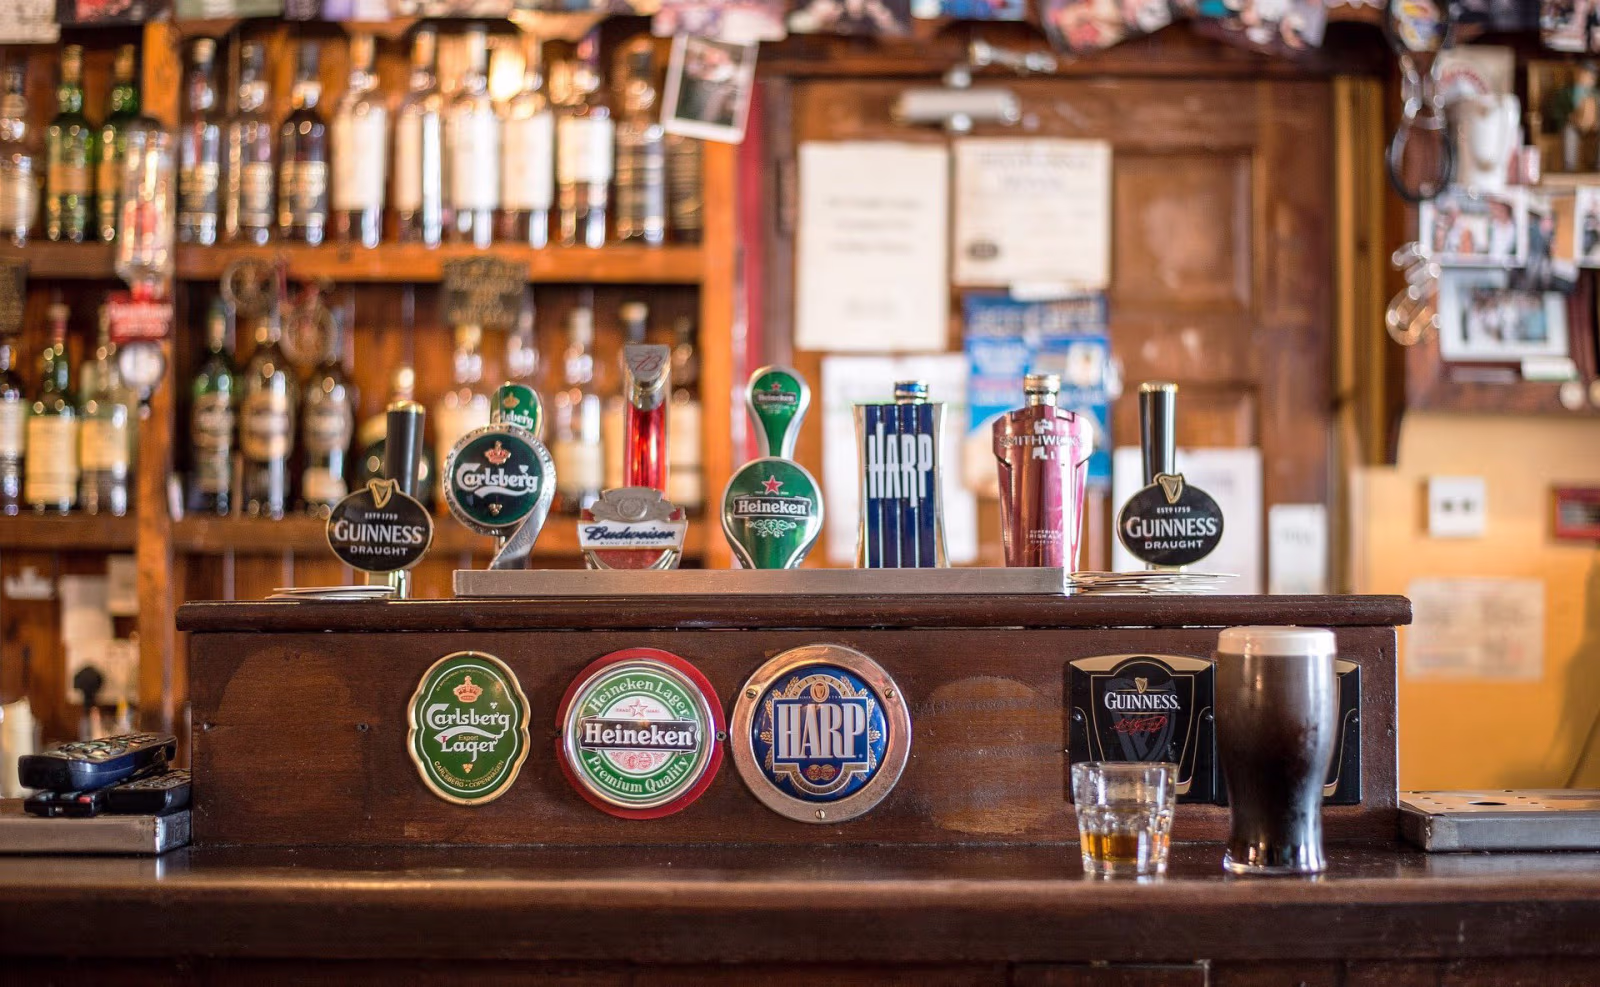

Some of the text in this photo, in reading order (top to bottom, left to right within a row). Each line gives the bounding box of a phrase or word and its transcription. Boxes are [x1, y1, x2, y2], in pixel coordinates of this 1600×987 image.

[867, 421, 933, 508] HARP
[456, 462, 539, 494] Carlsberg
[738, 499, 807, 515] Heineken
[1174, 506, 1191, 514] 1759
[334, 520, 423, 545] GUINNESS
[584, 526, 676, 541] Budweiser
[1126, 516, 1217, 538] GUINNESS
[350, 545, 408, 556] DRAUGHT
[1144, 540, 1204, 550] DRAUGHT
[588, 677, 690, 716] Heineken Lager
[1104, 692, 1181, 710] GUINNESS
[426, 703, 511, 735] Carlsberg
[776, 703, 866, 760] HARP
[584, 722, 694, 747] Heineken
[440, 736, 499, 762] Lager
[434, 760, 465, 788] CARLSBERG
[468, 759, 505, 788] COPENHAGEN
[587, 755, 691, 793] Premium Quality
